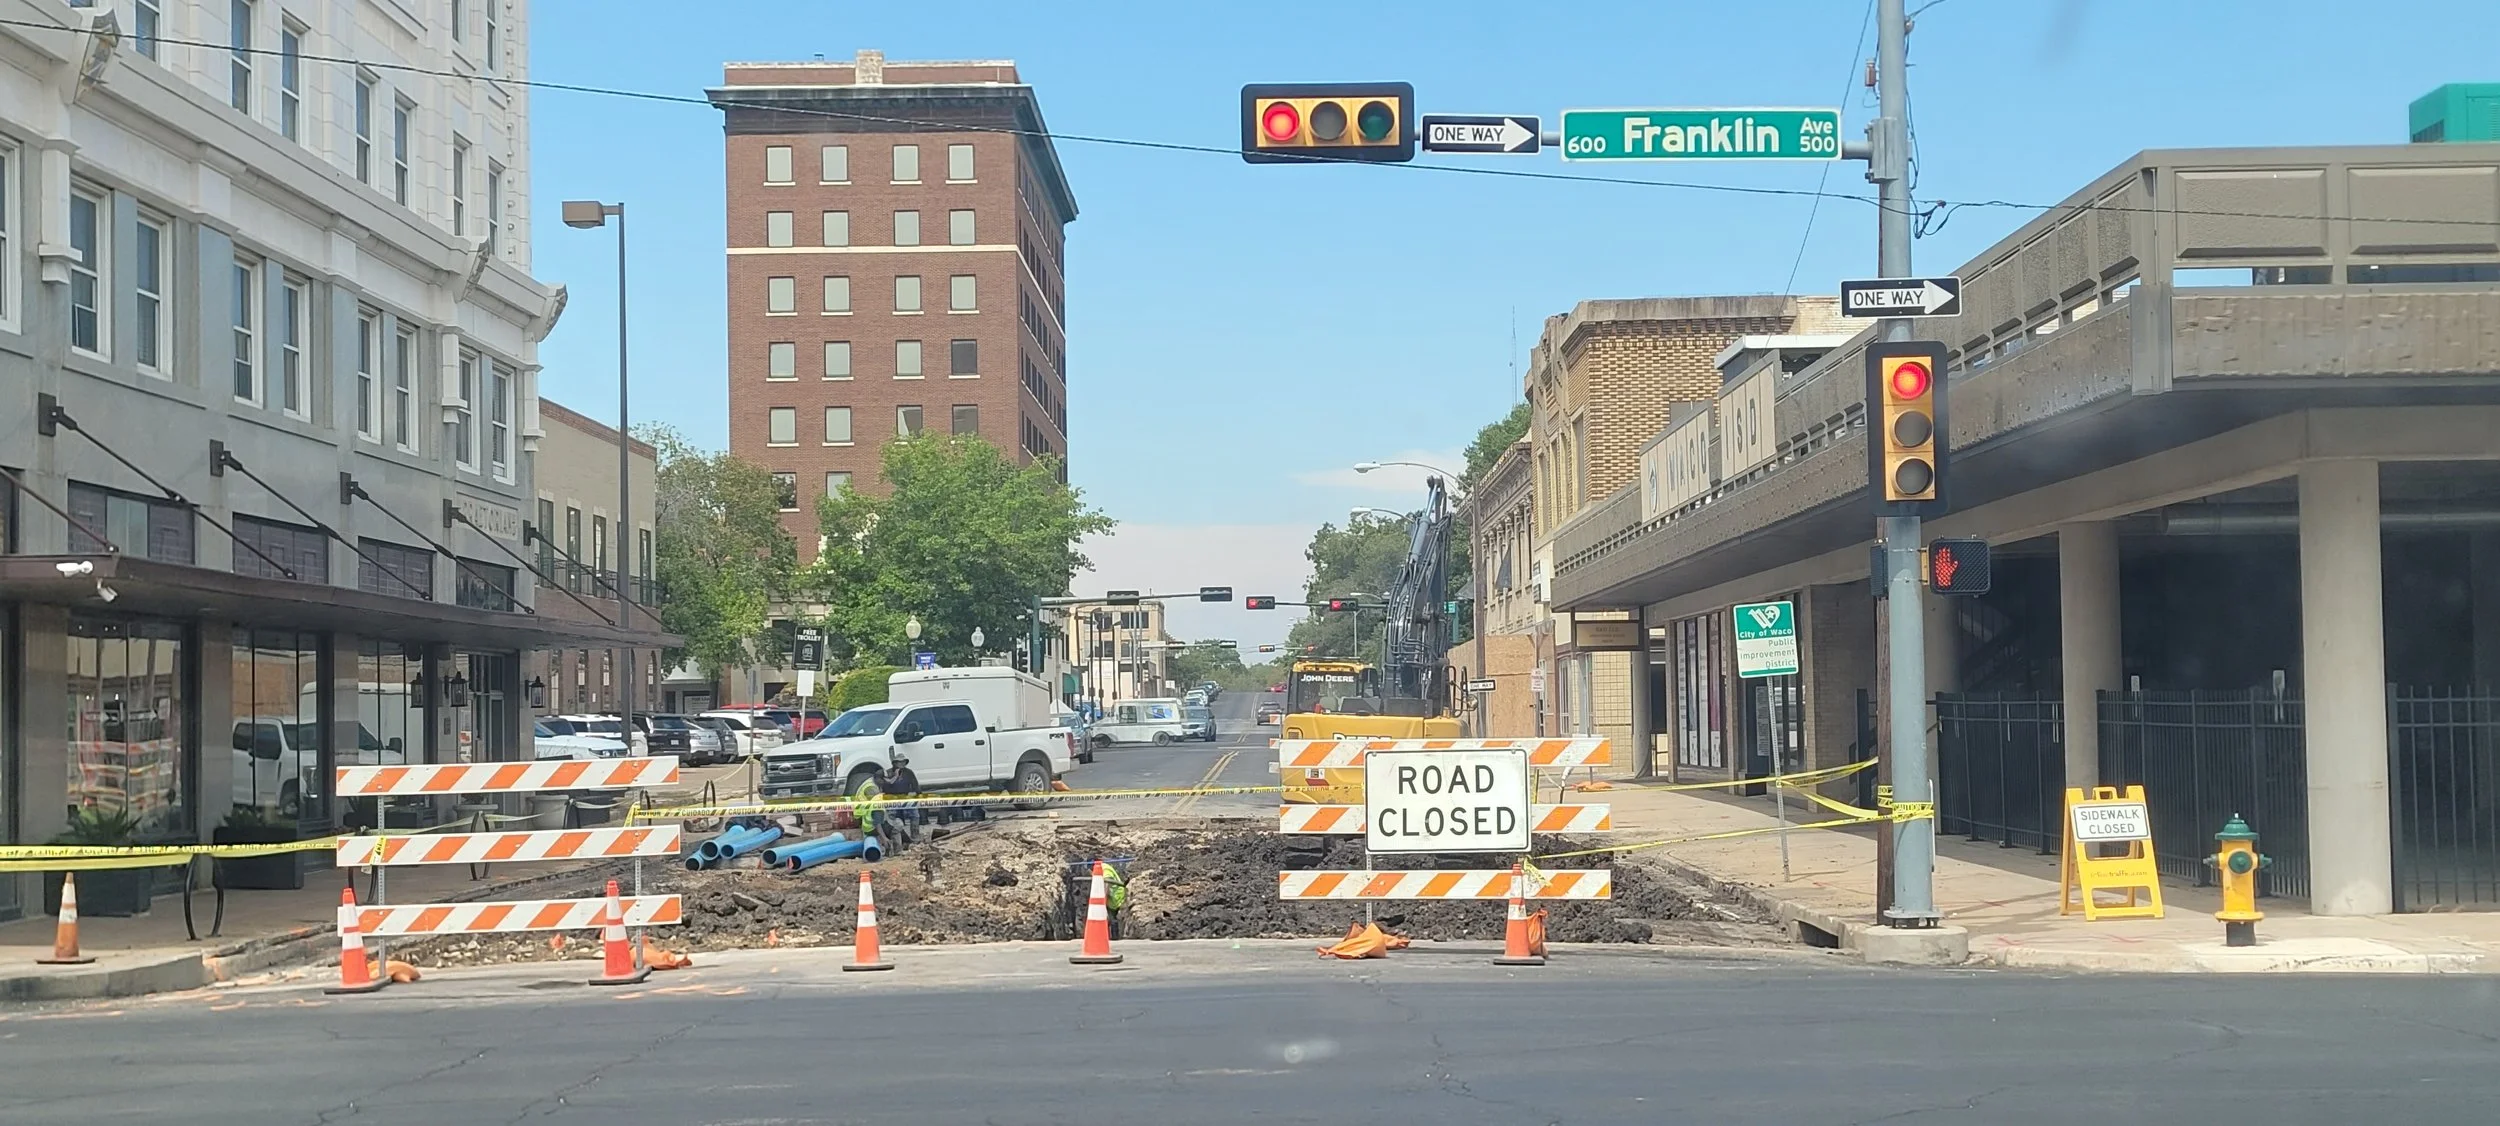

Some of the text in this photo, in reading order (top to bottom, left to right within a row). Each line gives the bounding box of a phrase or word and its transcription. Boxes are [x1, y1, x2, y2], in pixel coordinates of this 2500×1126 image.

[1800, 117, 1834, 134] Ave
[1434, 127, 1503, 142] ONE WAY
[1567, 117, 1780, 153] 600 Franklin
[1800, 136, 1835, 152] 500
[1853, 290, 1924, 306] ONE WAY
[1669, 398, 1757, 492] WACO ISD
[1739, 631, 1756, 639] City
[1770, 628, 1792, 636] Waco
[1768, 638, 1794, 647] Public
[1765, 659, 1796, 668] District
[1325, 674, 1355, 682] DEERE
[1398, 764, 1495, 795] ROAD
[682, 808, 710, 817] CUIDADO
[728, 807, 756, 815] CAUTION
[919, 799, 949, 807] CAUTION
[969, 797, 999, 805] CUIDADO
[2081, 809, 2140, 821] SIDEWALK
[1378, 806, 1516, 837] CLOSED
[2089, 823, 2135, 835] CLOSED
